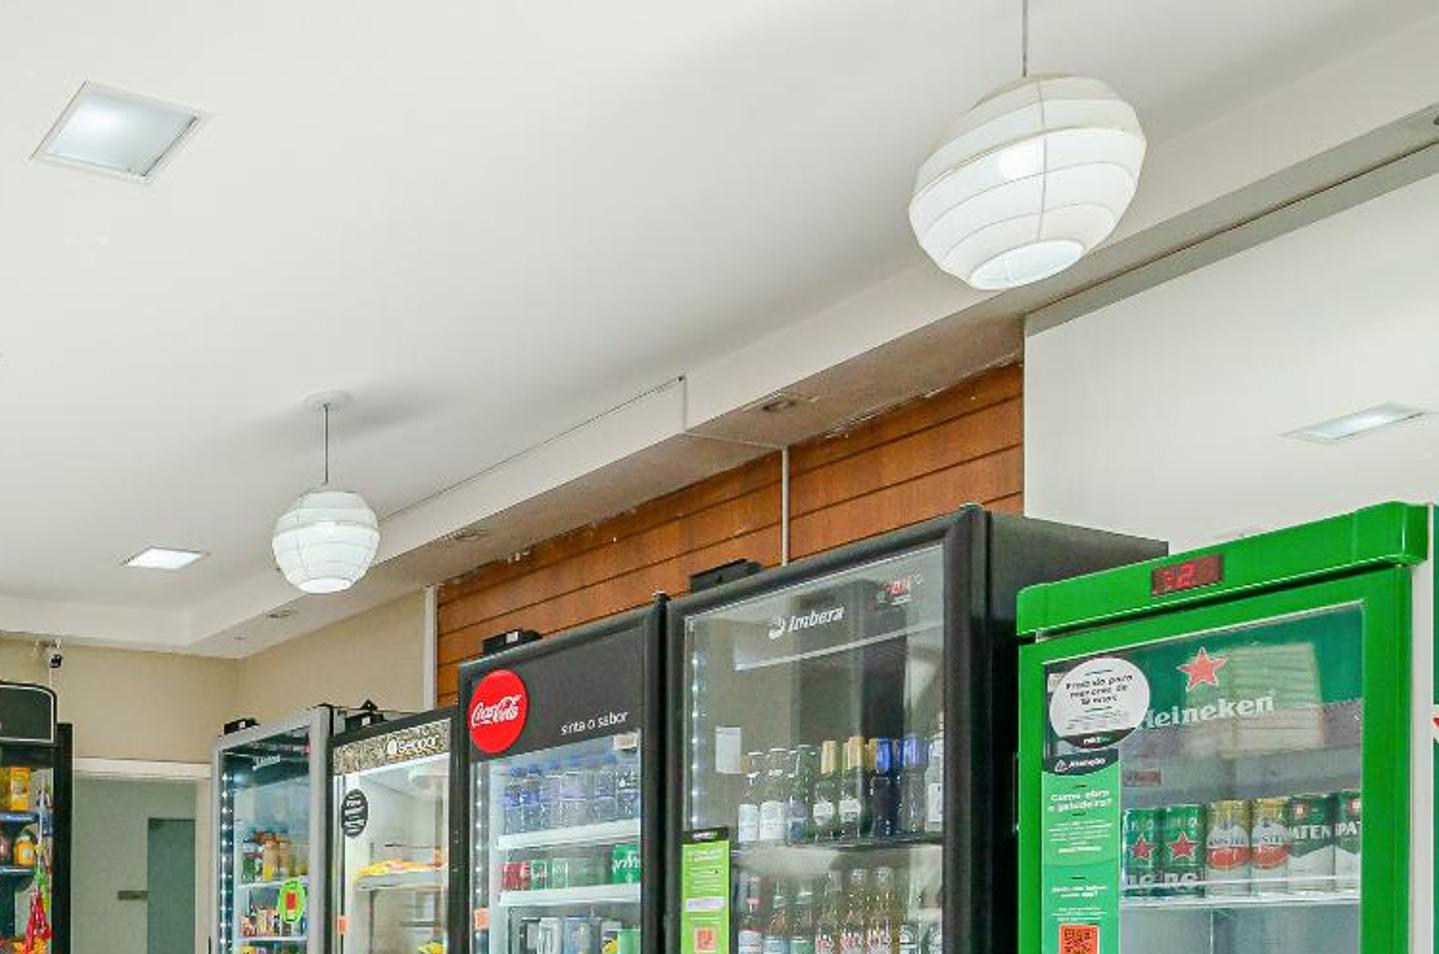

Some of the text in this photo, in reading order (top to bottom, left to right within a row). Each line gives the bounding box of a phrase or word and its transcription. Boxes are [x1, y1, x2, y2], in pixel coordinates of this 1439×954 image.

[788, 606, 844, 632] Imbera
[560, 711, 629, 736] sinta o sabor
